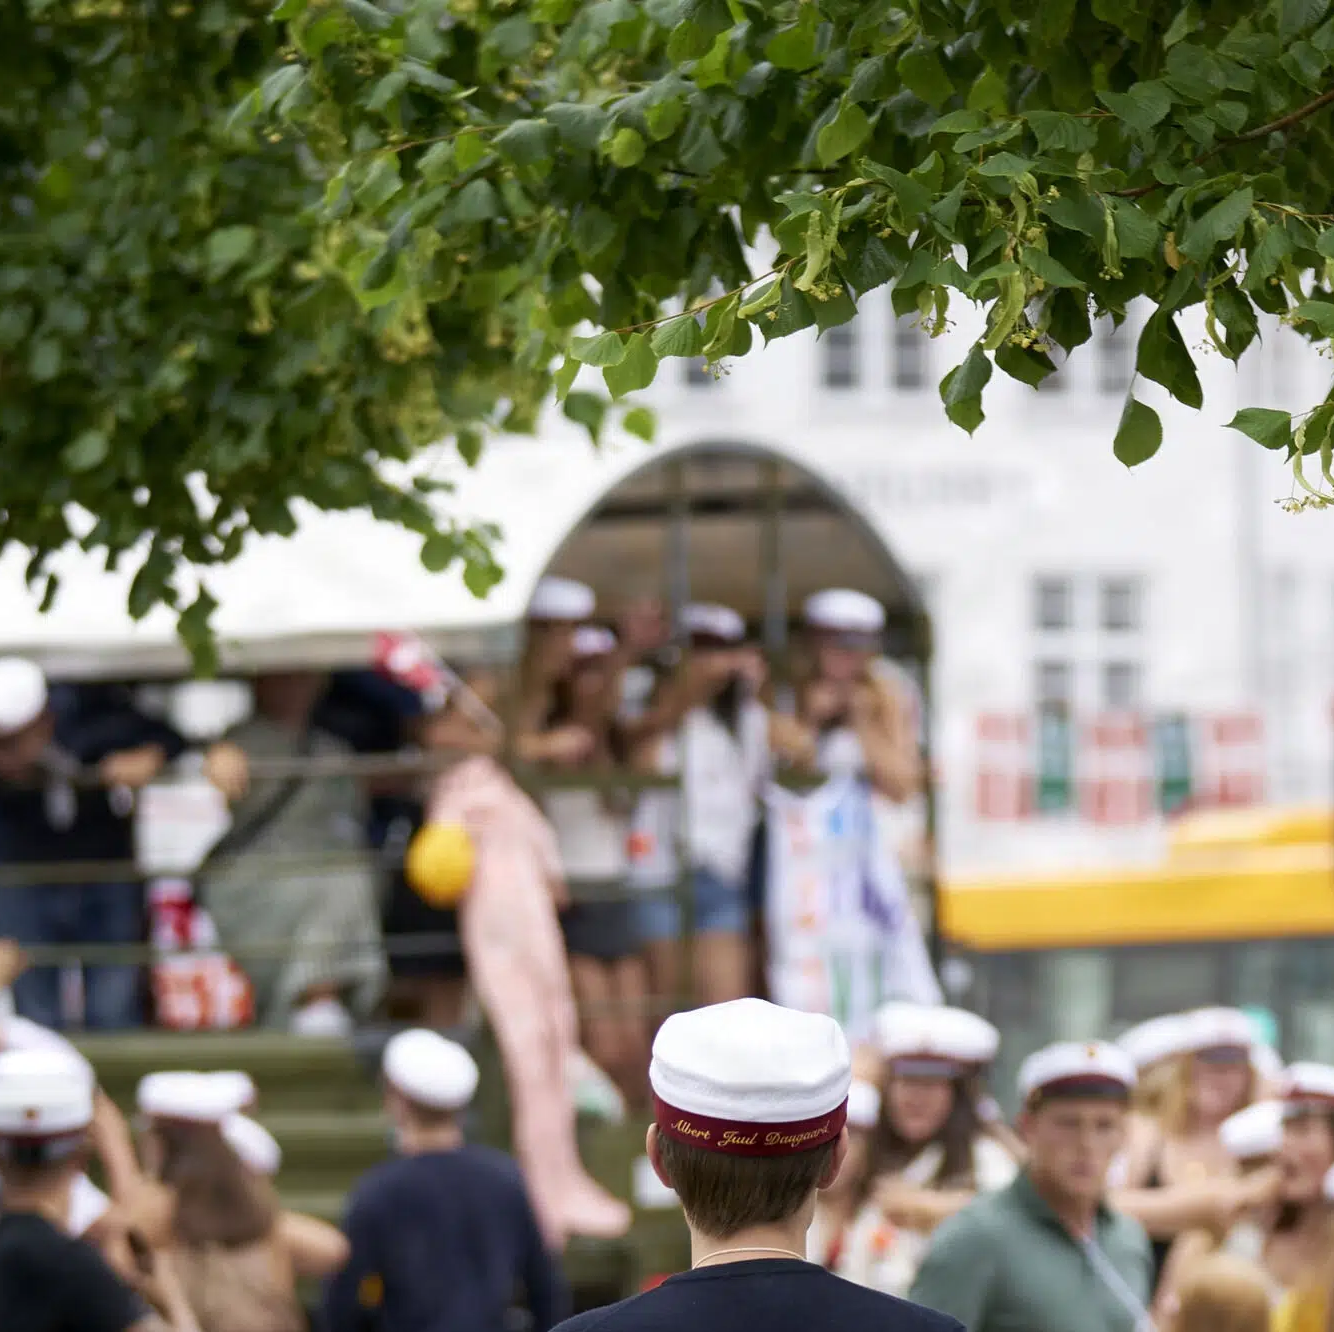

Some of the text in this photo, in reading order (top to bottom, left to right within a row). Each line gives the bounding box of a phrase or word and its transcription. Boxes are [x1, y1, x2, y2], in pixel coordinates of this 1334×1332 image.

[671, 1119, 830, 1148] Albert Juul Daugaard
